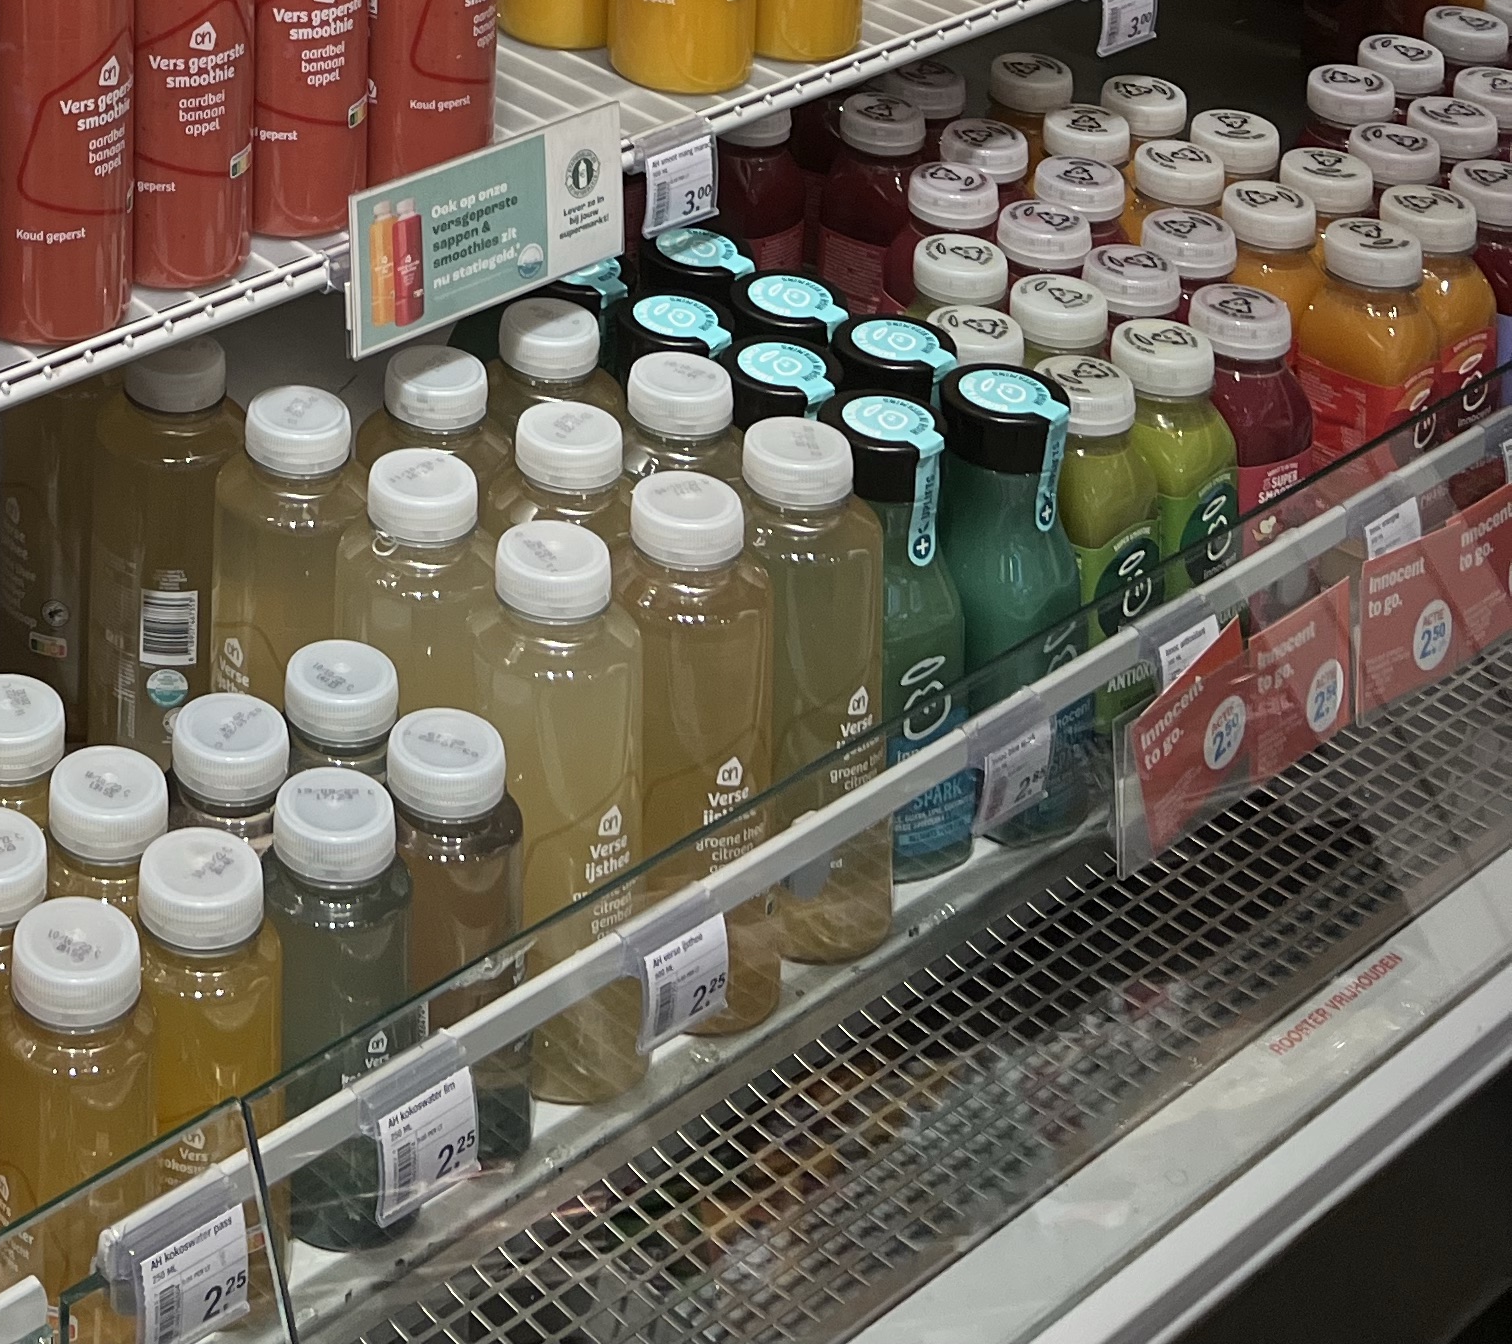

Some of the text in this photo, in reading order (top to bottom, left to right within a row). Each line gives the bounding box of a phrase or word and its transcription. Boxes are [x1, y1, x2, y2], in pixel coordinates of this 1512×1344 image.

[431, 182, 508, 218] Ook op onze
[431, 194, 519, 236] versgeperste
[563, 195, 605, 217] Lever ze in
[580, 209, 599, 223] jouw
[682, 184, 712, 216] 3.00
[432, 220, 491, 253] sappen &
[432, 227, 518, 269] smoothies zit
[432, 274, 451, 289] nu
[1369, 556, 1425, 593] Innocent
[1368, 592, 1404, 617] to go.
[589, 835, 628, 860] Verse
[585, 851, 630, 883] ijsthee
[689, 972, 726, 1017] 2.25
[1269, 952, 1403, 1055] ROOSTER VRIJHOUDEN
[388, 1114, 399, 1129] AH
[399, 1087, 443, 1123] kokoswater
[435, 1130, 476, 1179] 2.25
[149, 1216, 233, 1272] AH kokoswater pass
[202, 1269, 247, 1323] 2.25
